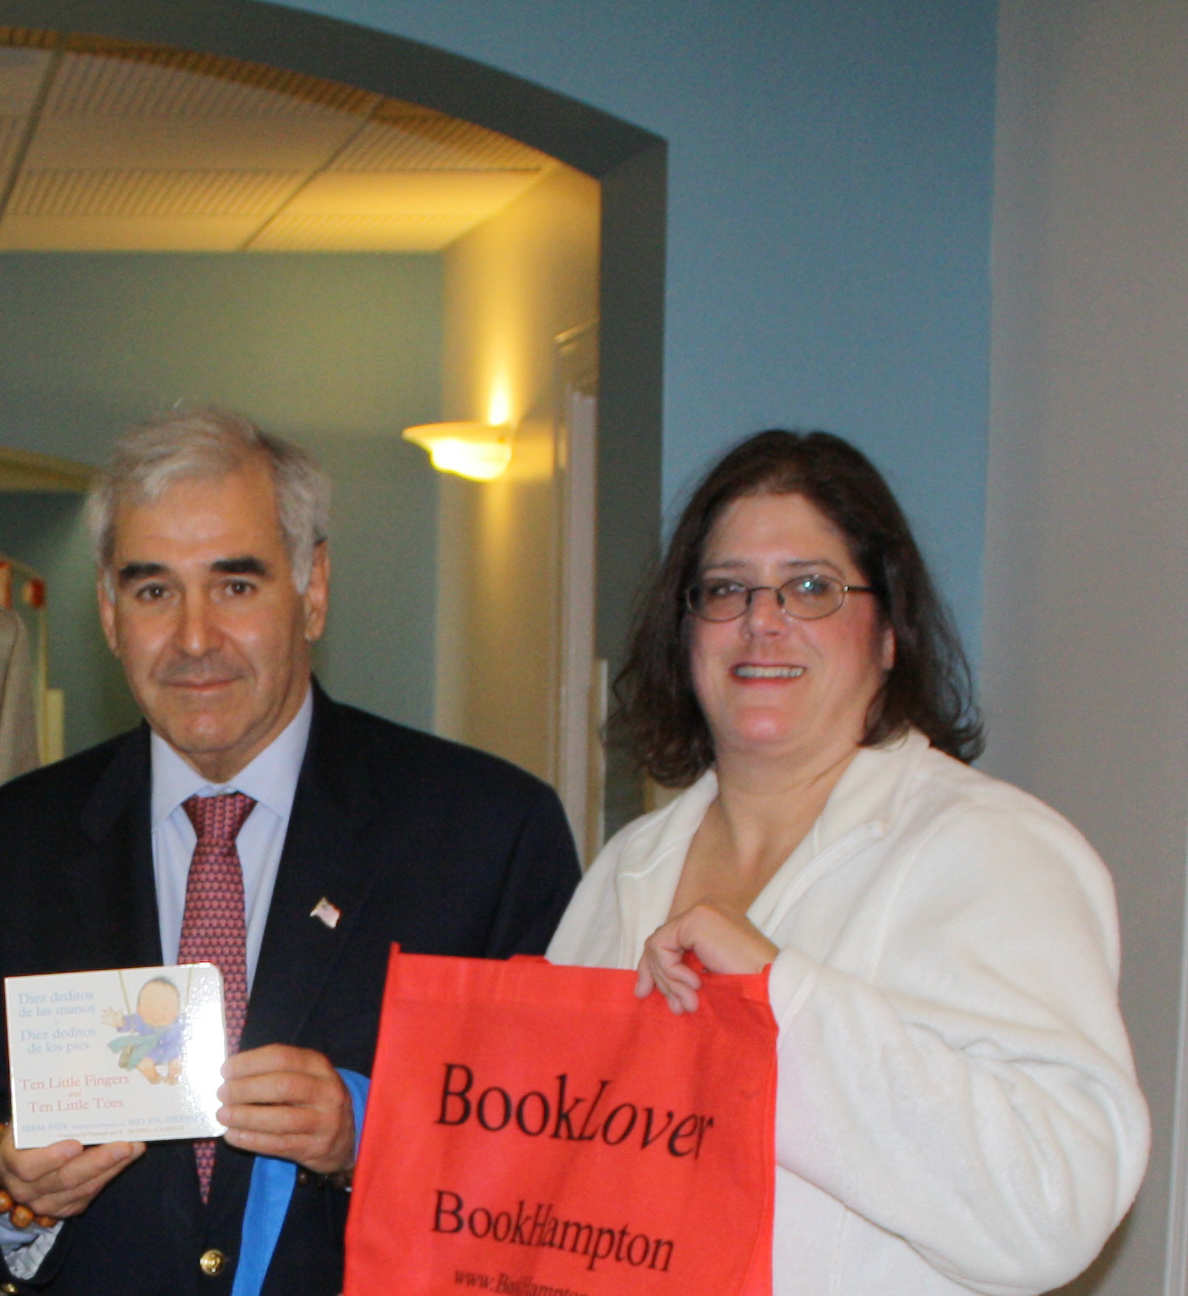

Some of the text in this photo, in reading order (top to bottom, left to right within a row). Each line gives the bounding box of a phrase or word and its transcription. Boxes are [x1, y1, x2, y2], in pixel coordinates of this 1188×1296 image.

[18, 990, 94, 1004] Diez deditos
[18, 1007, 32, 1017] de
[56, 1005, 96, 1015] manos
[21, 1027, 96, 1041] Diez deditos
[19, 1074, 129, 1090] Ten Little Fingers
[28, 1097, 124, 1113] Ten Little Toes
[434, 1062, 714, 1160] BookLover
[431, 1189, 675, 1272] BookHampton
